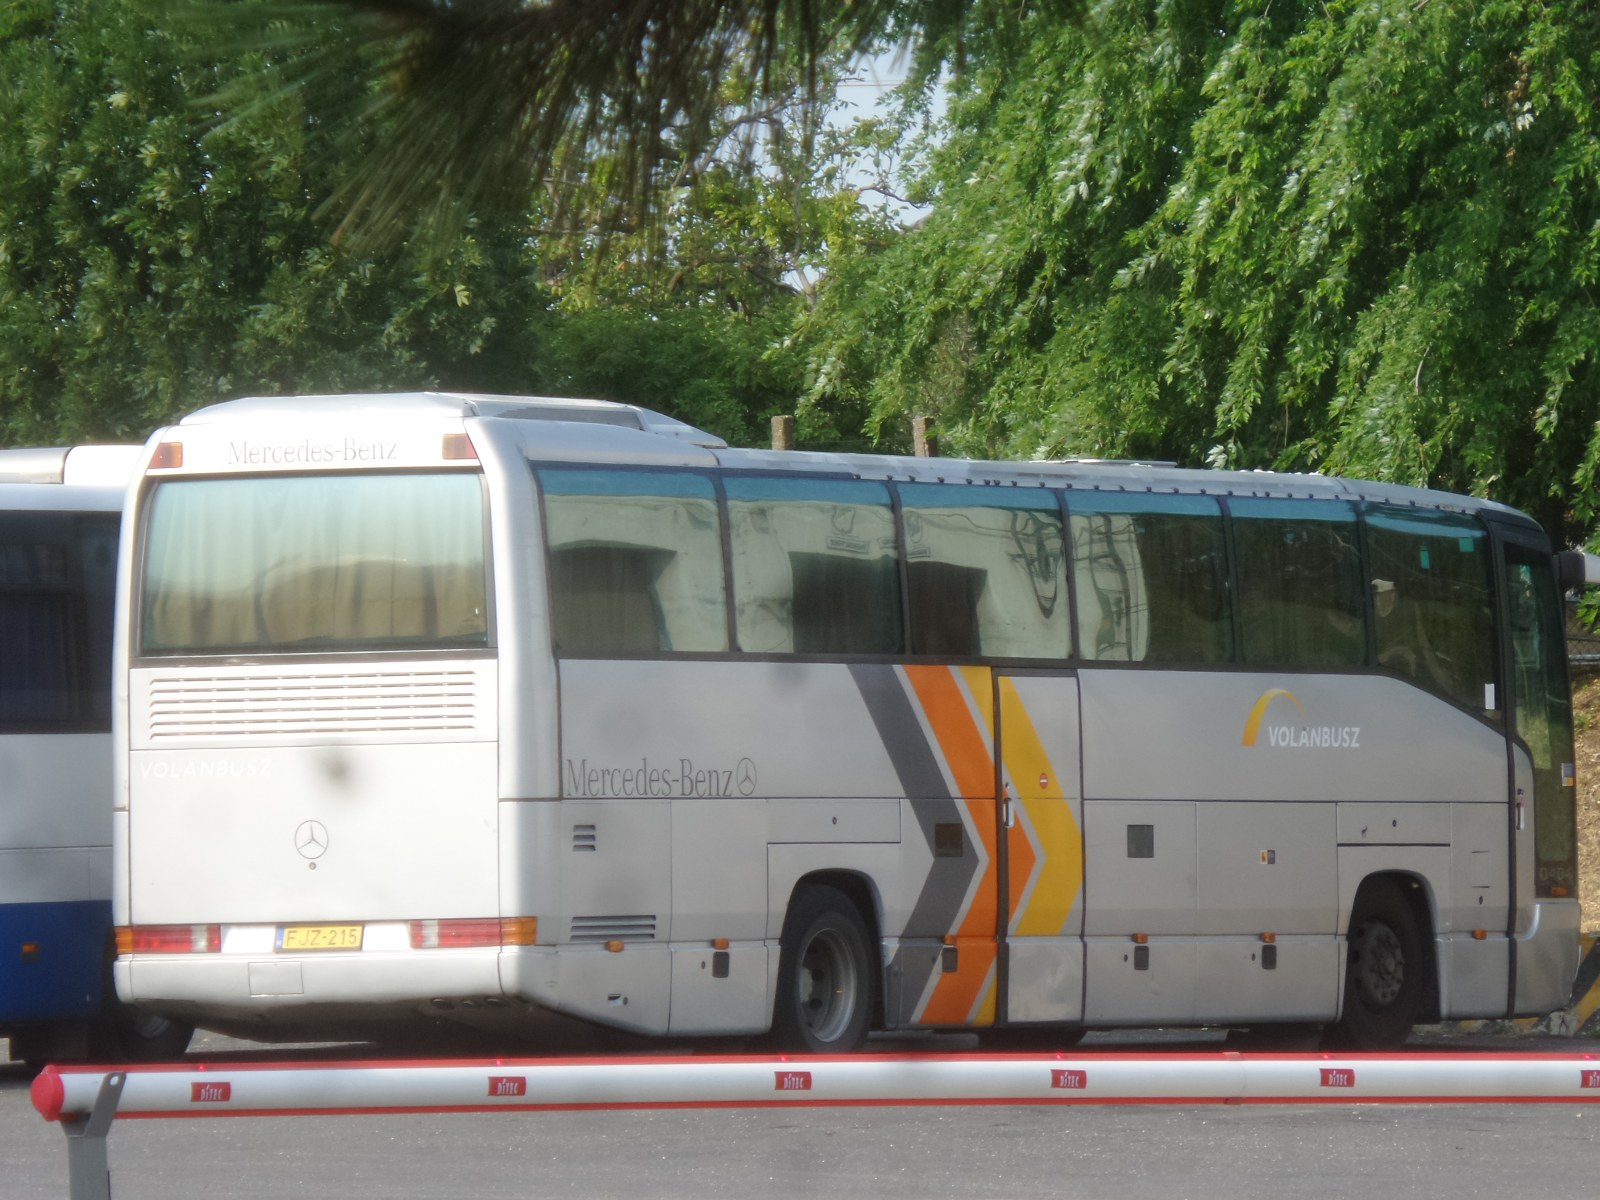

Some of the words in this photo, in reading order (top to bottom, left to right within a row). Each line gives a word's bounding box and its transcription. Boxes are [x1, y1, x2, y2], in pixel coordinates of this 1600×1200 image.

[228, 438, 398, 464] Mercedes-Benz
[567, 757, 733, 797] Mercedes-Benz
[286, 928, 358, 947] FJZ-215
